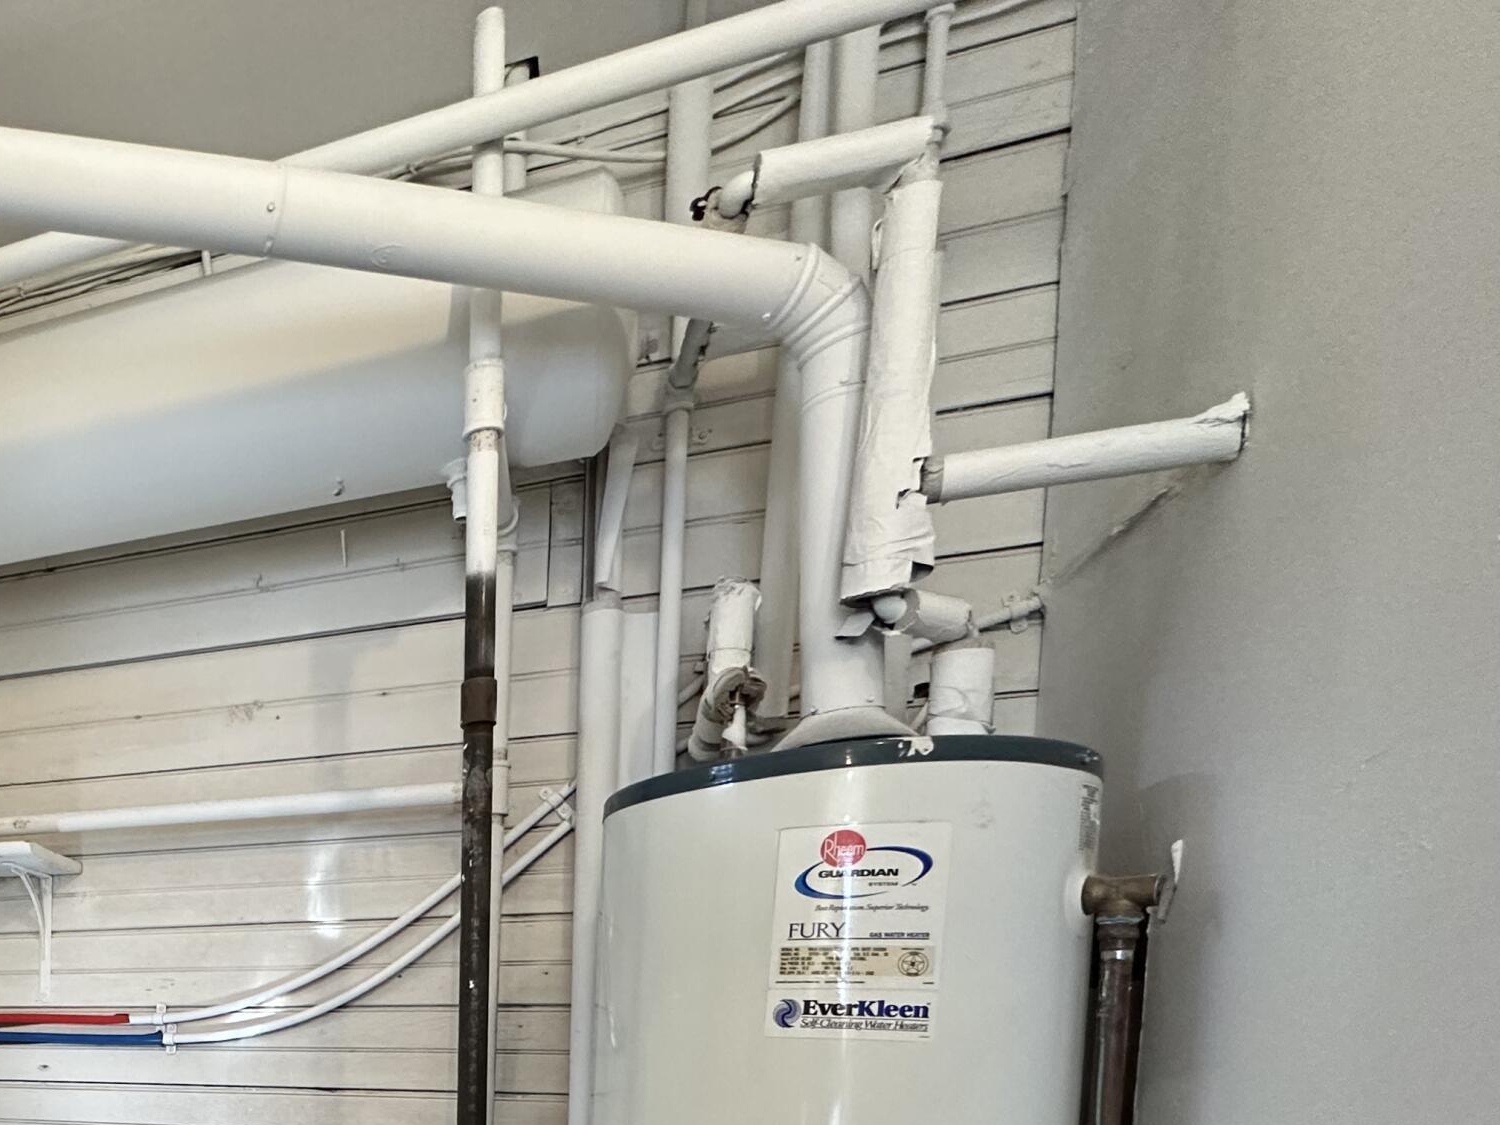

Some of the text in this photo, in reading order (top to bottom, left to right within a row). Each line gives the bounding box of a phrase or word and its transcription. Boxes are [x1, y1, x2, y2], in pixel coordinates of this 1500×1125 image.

[824, 832, 864, 861] Rheem
[818, 868, 899, 878] GUARDIAN
[788, 922, 847, 938] FURY
[802, 1000, 930, 1019] EverKleen
[801, 1018, 864, 1031] Self-Cleaning
[864, 1020, 892, 1029] Water
